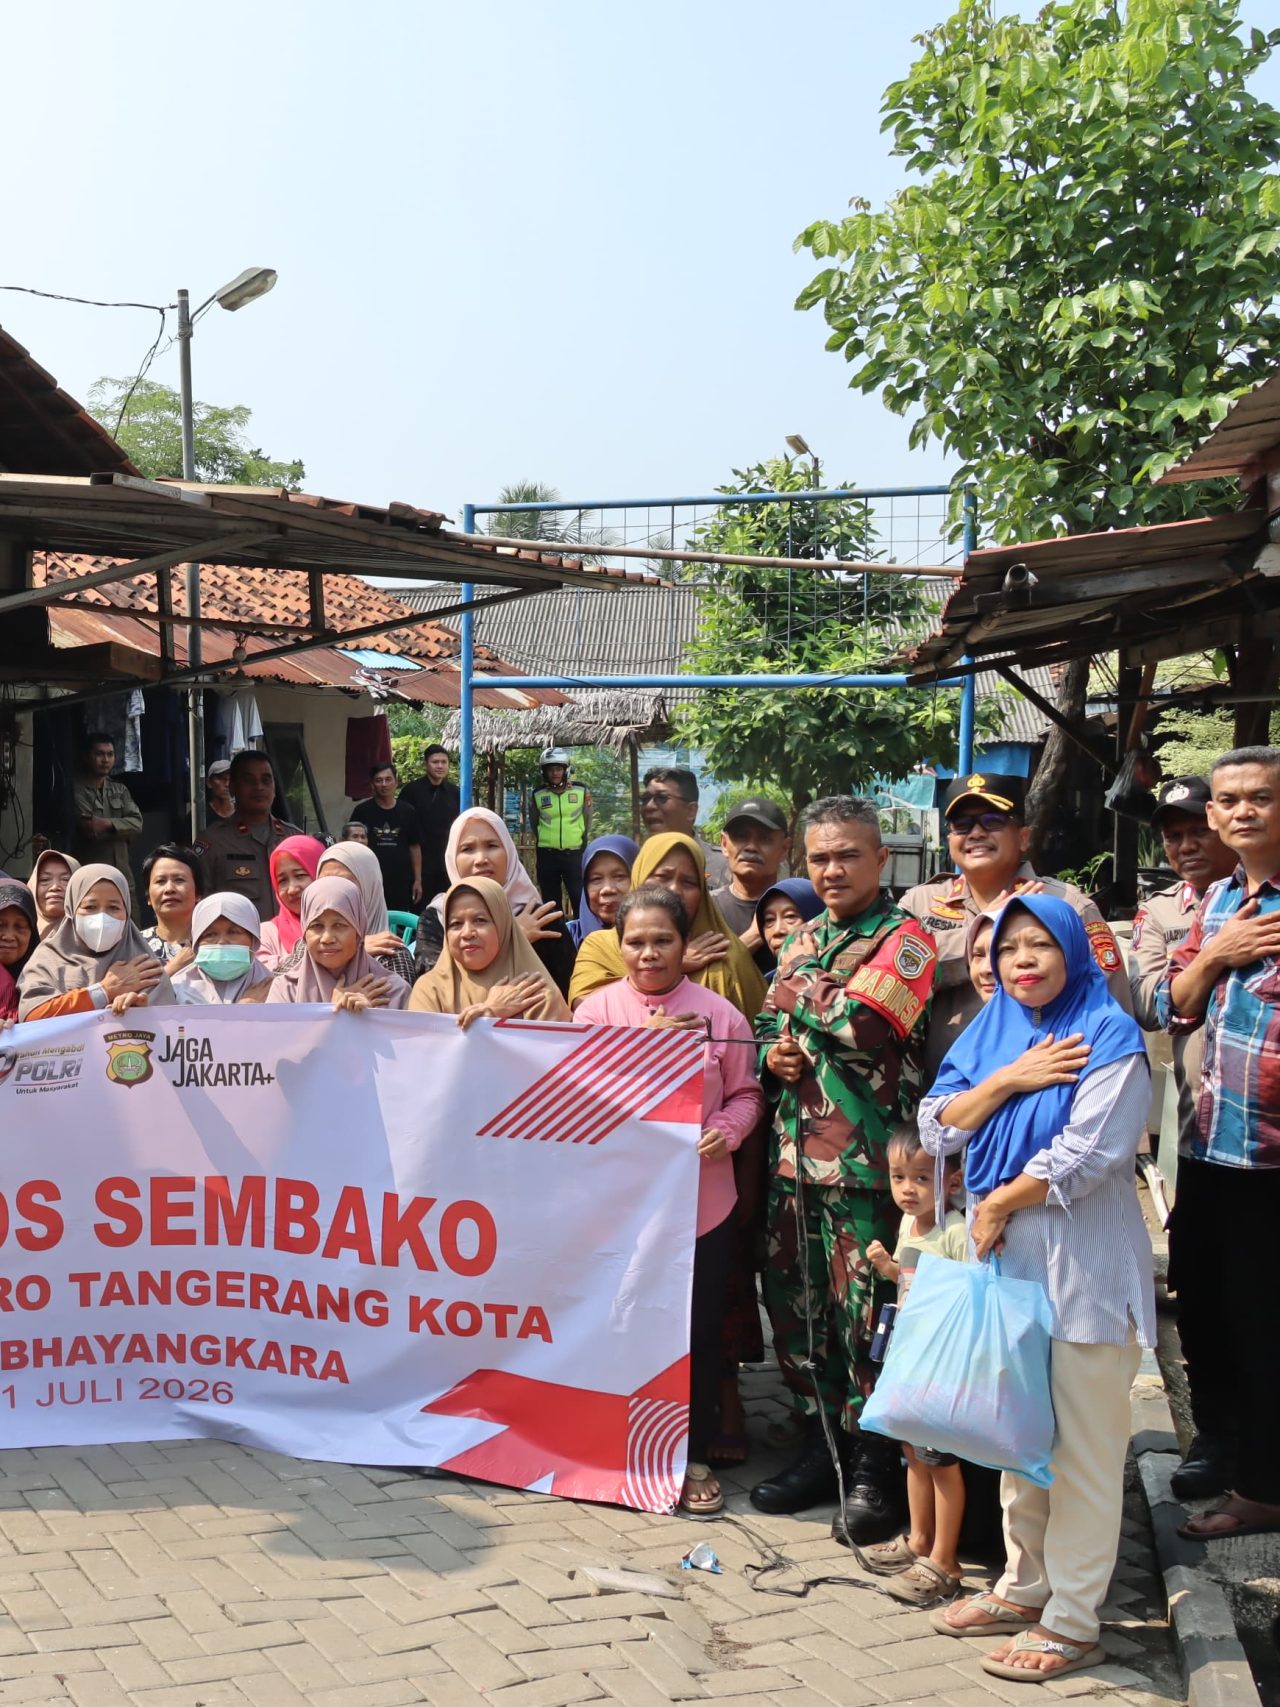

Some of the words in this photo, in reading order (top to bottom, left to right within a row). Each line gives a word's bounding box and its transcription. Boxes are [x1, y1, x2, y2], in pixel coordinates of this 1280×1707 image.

[107, 1033, 133, 1041] METRO
[134, 1032, 151, 1040] JAYA
[158, 1034, 213, 1062] JAGA
[39, 1082, 78, 1093] Masyarakat
[95, 1175, 497, 1277] SEMBAKO
[69, 1270, 389, 1327] TANGERANG
[410, 1296, 552, 1343] KOTA
[1, 1334, 350, 1384] BHAYANGKARA
[2, 1385, 17, 1409] 1
[35, 1377, 122, 1406] JULI
[138, 1378, 234, 1404] 2026
